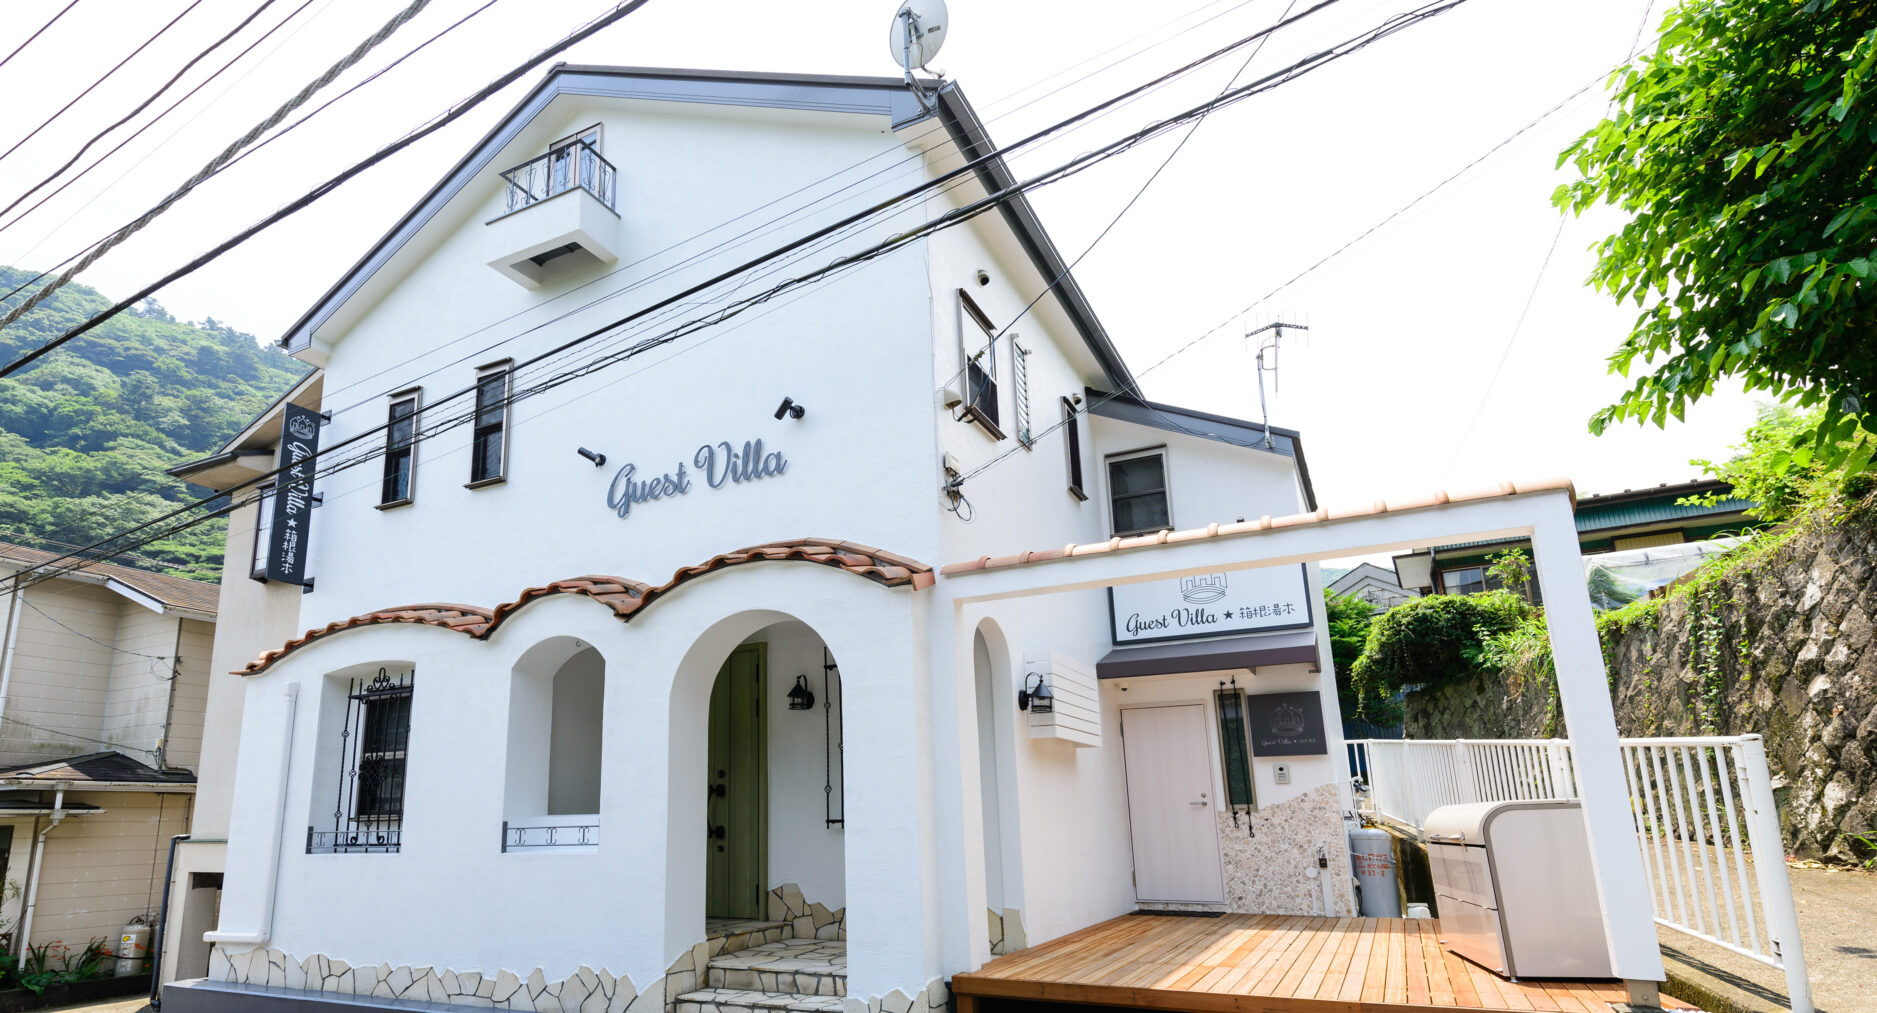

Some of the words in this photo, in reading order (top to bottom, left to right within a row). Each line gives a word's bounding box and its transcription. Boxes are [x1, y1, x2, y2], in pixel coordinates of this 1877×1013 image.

[607, 462, 692, 518] Guest
[694, 438, 788, 488] Villa
[286, 480, 310, 515] Villa
[1126, 613, 1170, 636] Guest
[1171, 608, 1218, 627] Villa
[1239, 602, 1296, 620] 箱根湯本
